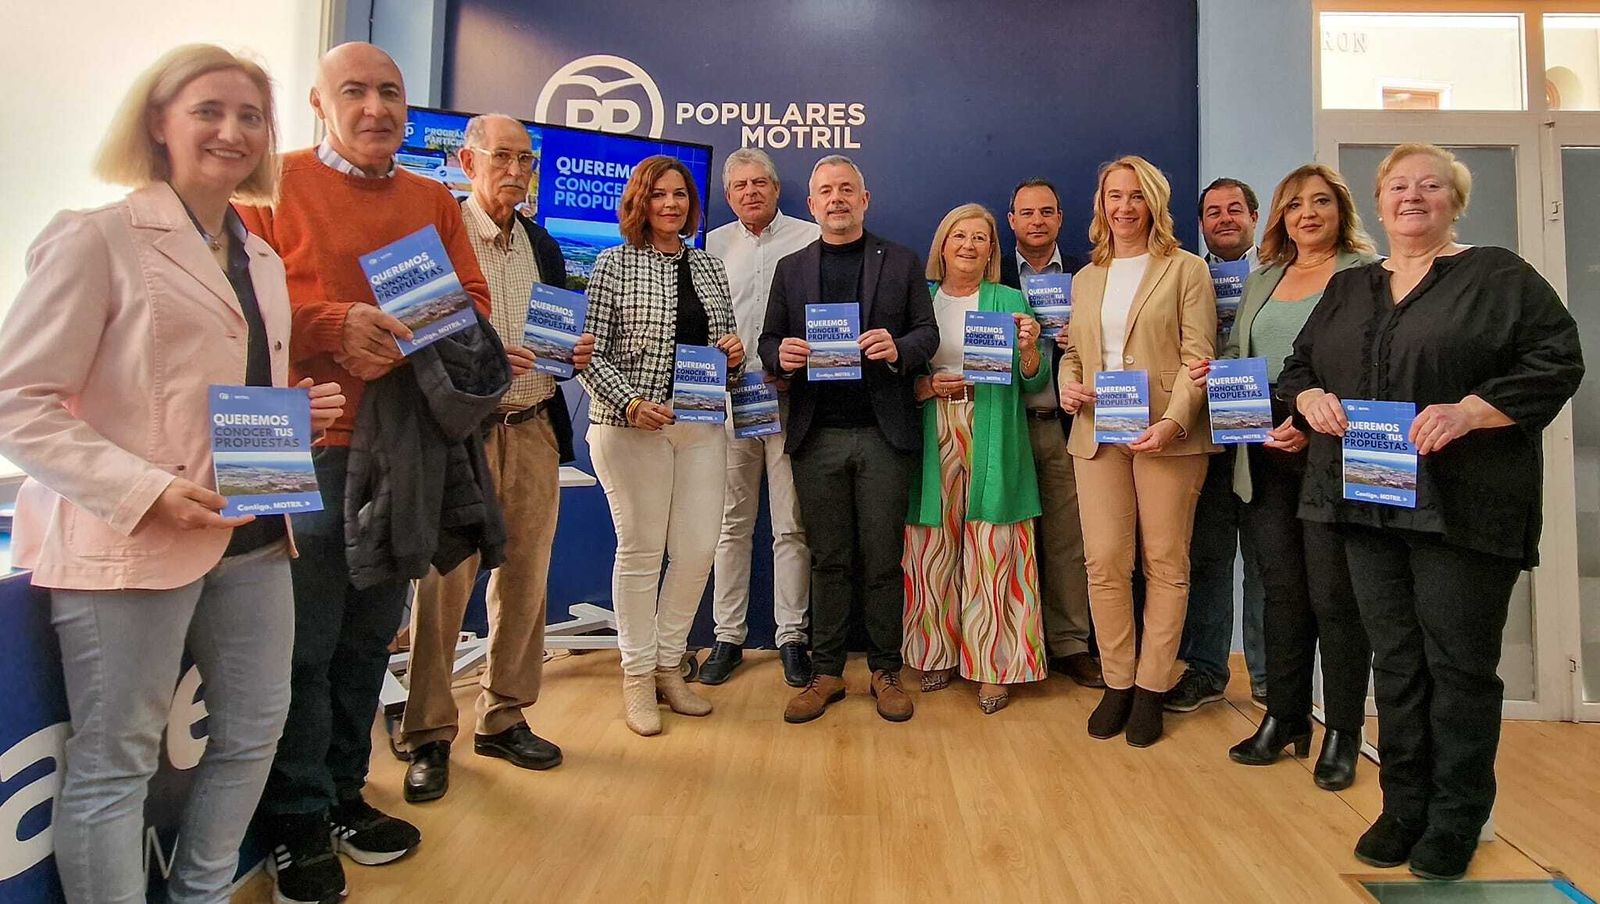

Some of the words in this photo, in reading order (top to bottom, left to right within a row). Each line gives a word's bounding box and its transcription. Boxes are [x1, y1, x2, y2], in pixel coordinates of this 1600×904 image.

[676, 102, 866, 125] POPULARES
[741, 125, 861, 148] MOTRIL
[371, 252, 430, 285] QUEREMOS
[375, 268, 419, 293] CONOCER
[419, 260, 436, 272] TUS
[379, 265, 444, 300] PROPUESTAS
[1028, 287, 1062, 295] QUEREMOS
[530, 300, 573, 317] QUEREMOS
[528, 308, 563, 322] CONOCER
[562, 316, 575, 325] TUS
[438, 320, 462, 334] MOTRIL
[528, 315, 577, 333] PROPUESTAS
[807, 319, 848, 327] QUEREMOS
[966, 325, 1003, 334] QUEREMOS
[965, 332, 994, 340] CONOCER
[965, 338, 1007, 346] PROPUESTAS
[677, 360, 715, 369] QUEREMOS
[676, 368, 706, 376] CONOCER
[706, 369, 717, 377] TUS
[675, 375, 720, 383] PROPUESTAS
[1208, 376, 1254, 386] QUEREMOS
[732, 383, 766, 394] QUEREMOS
[1096, 386, 1136, 394] QUEREMOS
[1209, 384, 1245, 392] CONOCER
[1209, 390, 1263, 399] PROPUESTAS
[1096, 398, 1142, 406] PROPUESTAS
[213, 413, 289, 426] QUEREMOS
[1347, 420, 1399, 433] QUEREMOS
[214, 427, 273, 438] CONOCER
[274, 428, 294, 437] TUS
[1344, 430, 1387, 441] CONOCER
[1387, 433, 1403, 442] TUS
[215, 438, 300, 448] PROPUESTAS
[1344, 438, 1408, 451] PROPUESTAS
[1379, 493, 1402, 502] MOTRIL
[237, 503, 272, 513] Contigo,
[273, 501, 303, 509] MOTRIL
